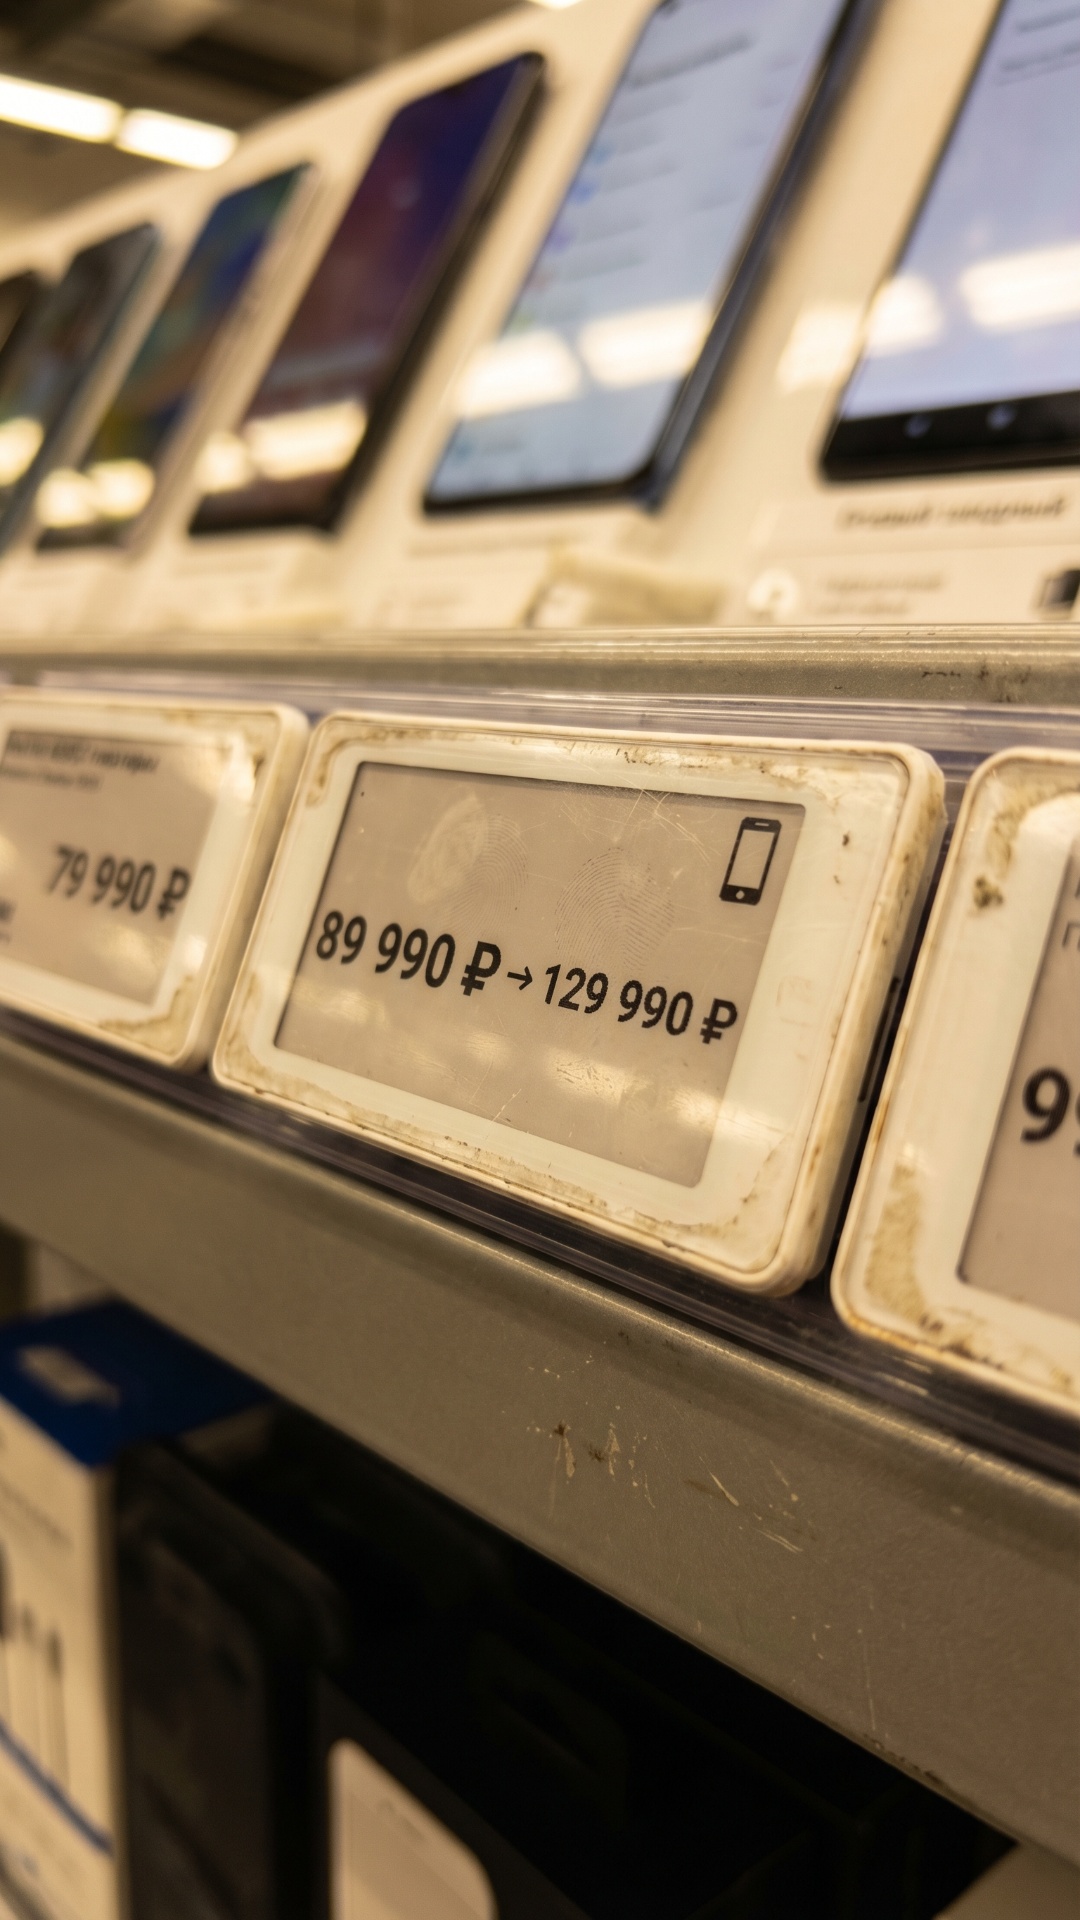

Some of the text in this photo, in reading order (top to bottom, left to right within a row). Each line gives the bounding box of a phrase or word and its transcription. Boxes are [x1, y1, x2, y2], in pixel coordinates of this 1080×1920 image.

[49, 844, 191, 920] 79 990 ₽
[315, 910, 738, 1045] 89 990 ₽ 129 990 ₽
[1021, 1066, 1080, 1157] 9
